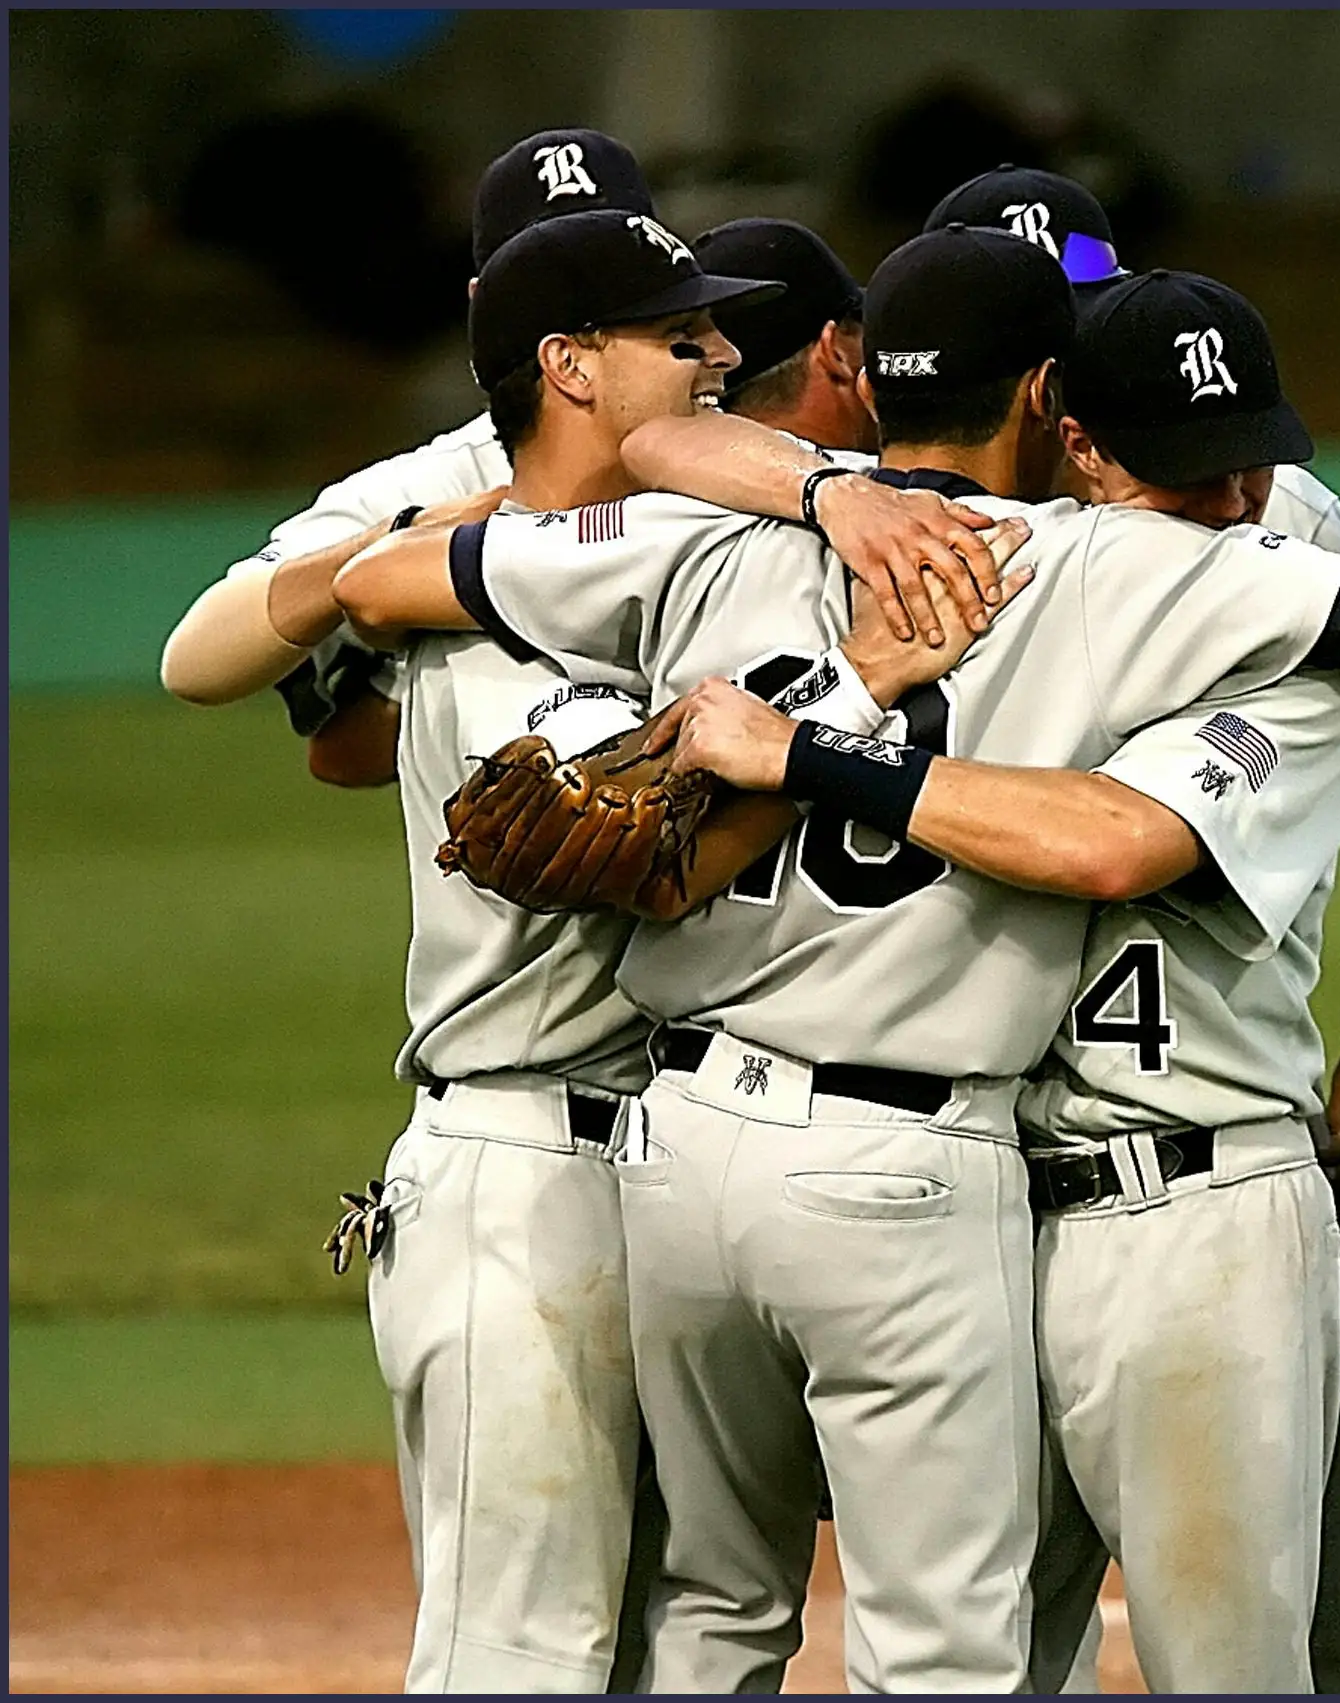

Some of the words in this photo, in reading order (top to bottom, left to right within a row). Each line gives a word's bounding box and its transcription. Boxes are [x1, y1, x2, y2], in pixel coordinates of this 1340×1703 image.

[532, 142, 597, 202] R
[876, 350, 940, 377] TPX
[1173, 326, 1239, 403] R
[812, 723, 914, 767] TPX
[1071, 937, 1179, 1077] 4
